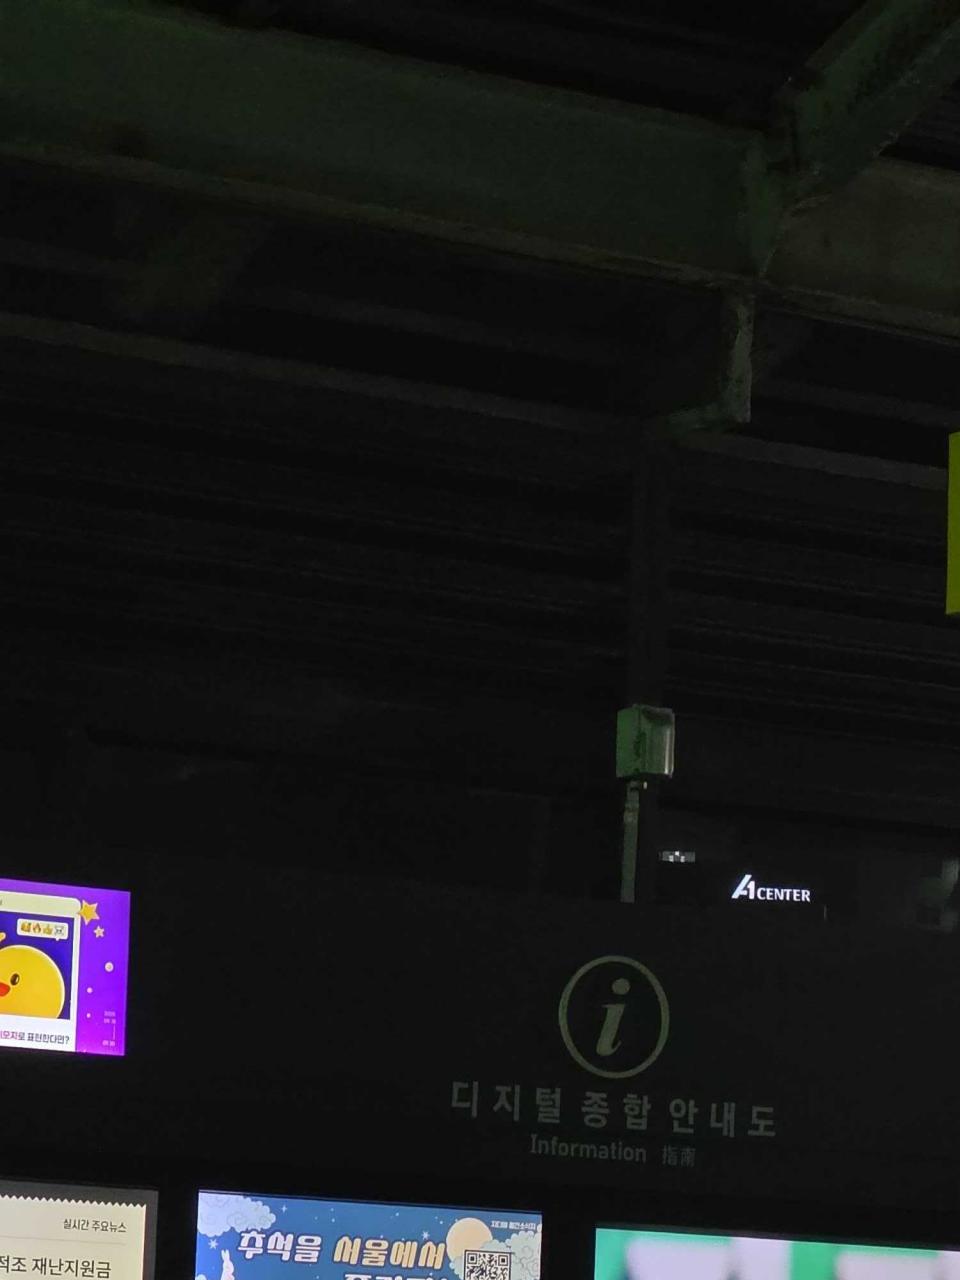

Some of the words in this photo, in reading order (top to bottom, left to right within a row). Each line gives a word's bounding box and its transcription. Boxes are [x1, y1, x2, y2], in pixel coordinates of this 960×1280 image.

[757, 887, 811, 902] CENTER
[451, 1081, 561, 1124] 디지털
[581, 1091, 652, 1130] 종합
[668, 1098, 777, 1138] 안내도
[530, 1134, 647, 1162] Information
[63, 1218, 89, 1231] 실시간
[92, 1219, 127, 1233] 주요뉴스
[237, 1229, 322, 1263] 추석을
[333, 1235, 446, 1270] 서울에서
[32, 1256, 112, 1279] 재난지원금
